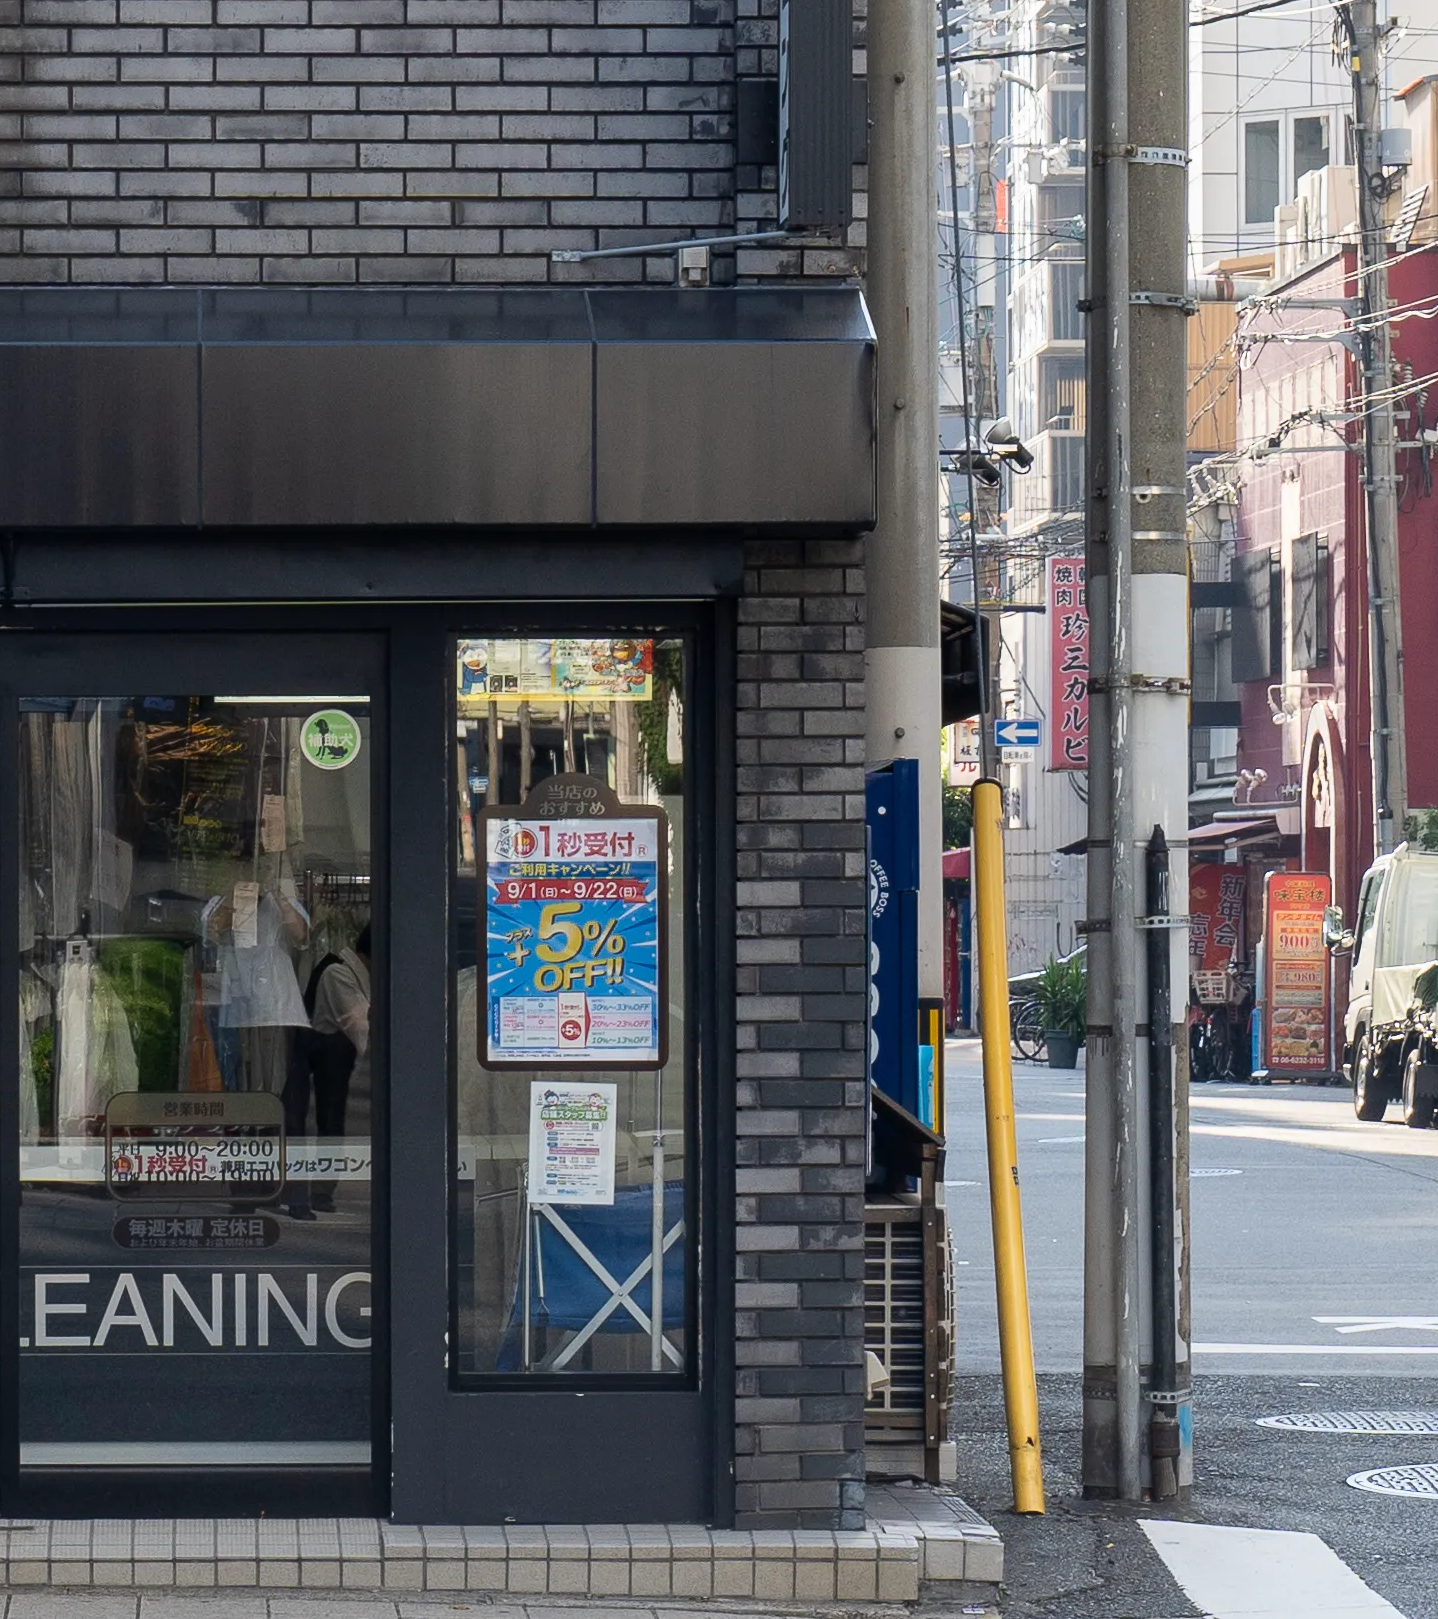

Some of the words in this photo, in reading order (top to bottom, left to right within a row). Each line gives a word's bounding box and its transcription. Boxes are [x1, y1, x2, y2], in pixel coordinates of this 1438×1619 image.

[1054, 566, 1074, 606] 焼肉
[307, 732, 354, 747] 補助犬
[548, 784, 598, 800] 当店の
[540, 801, 606, 816] おすすめ
[538, 825, 635, 858] 1秒受付
[1273, 888, 1325, 903] 味宝楼
[872, 892, 889, 919] BOSS
[1213, 873, 1247, 948] 新年会
[533, 958, 624, 993] OFF!!
[164, 1101, 225, 1118] 営業時間
[134, 1154, 208, 1174] 1秒受付
[129, 1219, 204, 1237] 毎週木曜
[210, 1219, 265, 1237] 定休日
